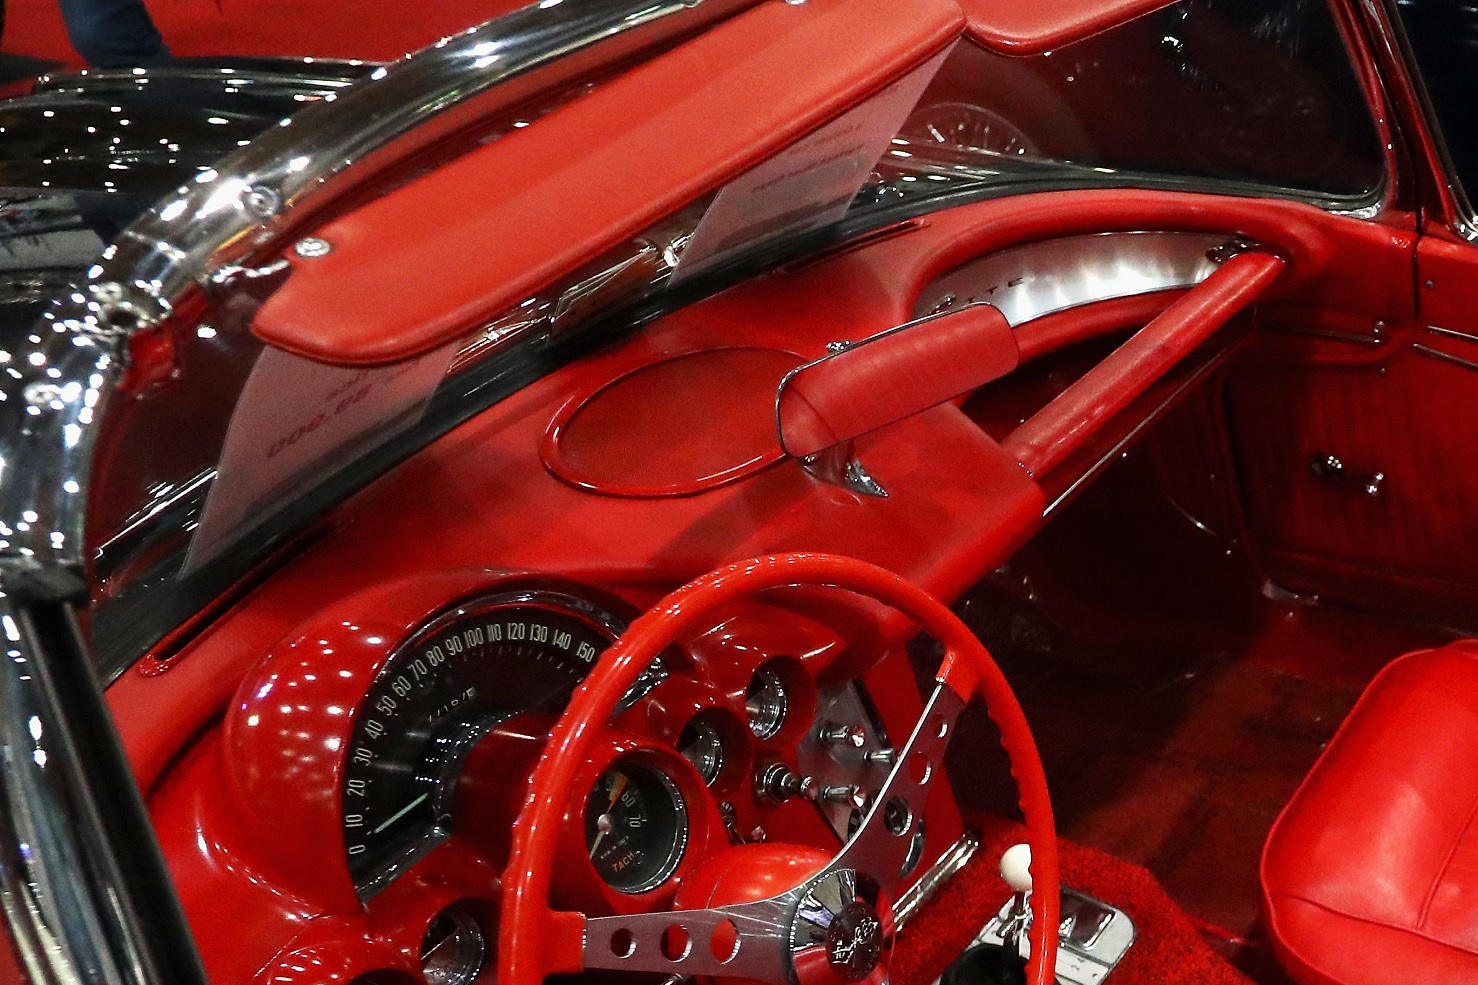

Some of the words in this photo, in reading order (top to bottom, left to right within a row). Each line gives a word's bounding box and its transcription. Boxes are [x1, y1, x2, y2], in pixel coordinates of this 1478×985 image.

[463, 627, 484, 647] 100
[486, 623, 502, 641] 110
[507, 622, 526, 640] 120
[529, 623, 548, 643] 130
[552, 629, 572, 650] 140
[445, 635, 463, 656] 90
[576, 641, 596, 663] 150
[426, 645, 445, 667] 80
[409, 659, 428, 681] 70
[391, 675, 412, 697] 60
[376, 695, 397, 716] 50
[364, 719, 384, 740] 40
[353, 747, 373, 765] 30
[346, 779, 366, 797] 20
[345, 814, 364, 828] 10
[629, 814, 641, 828] 70
[348, 844, 366, 855] 0
